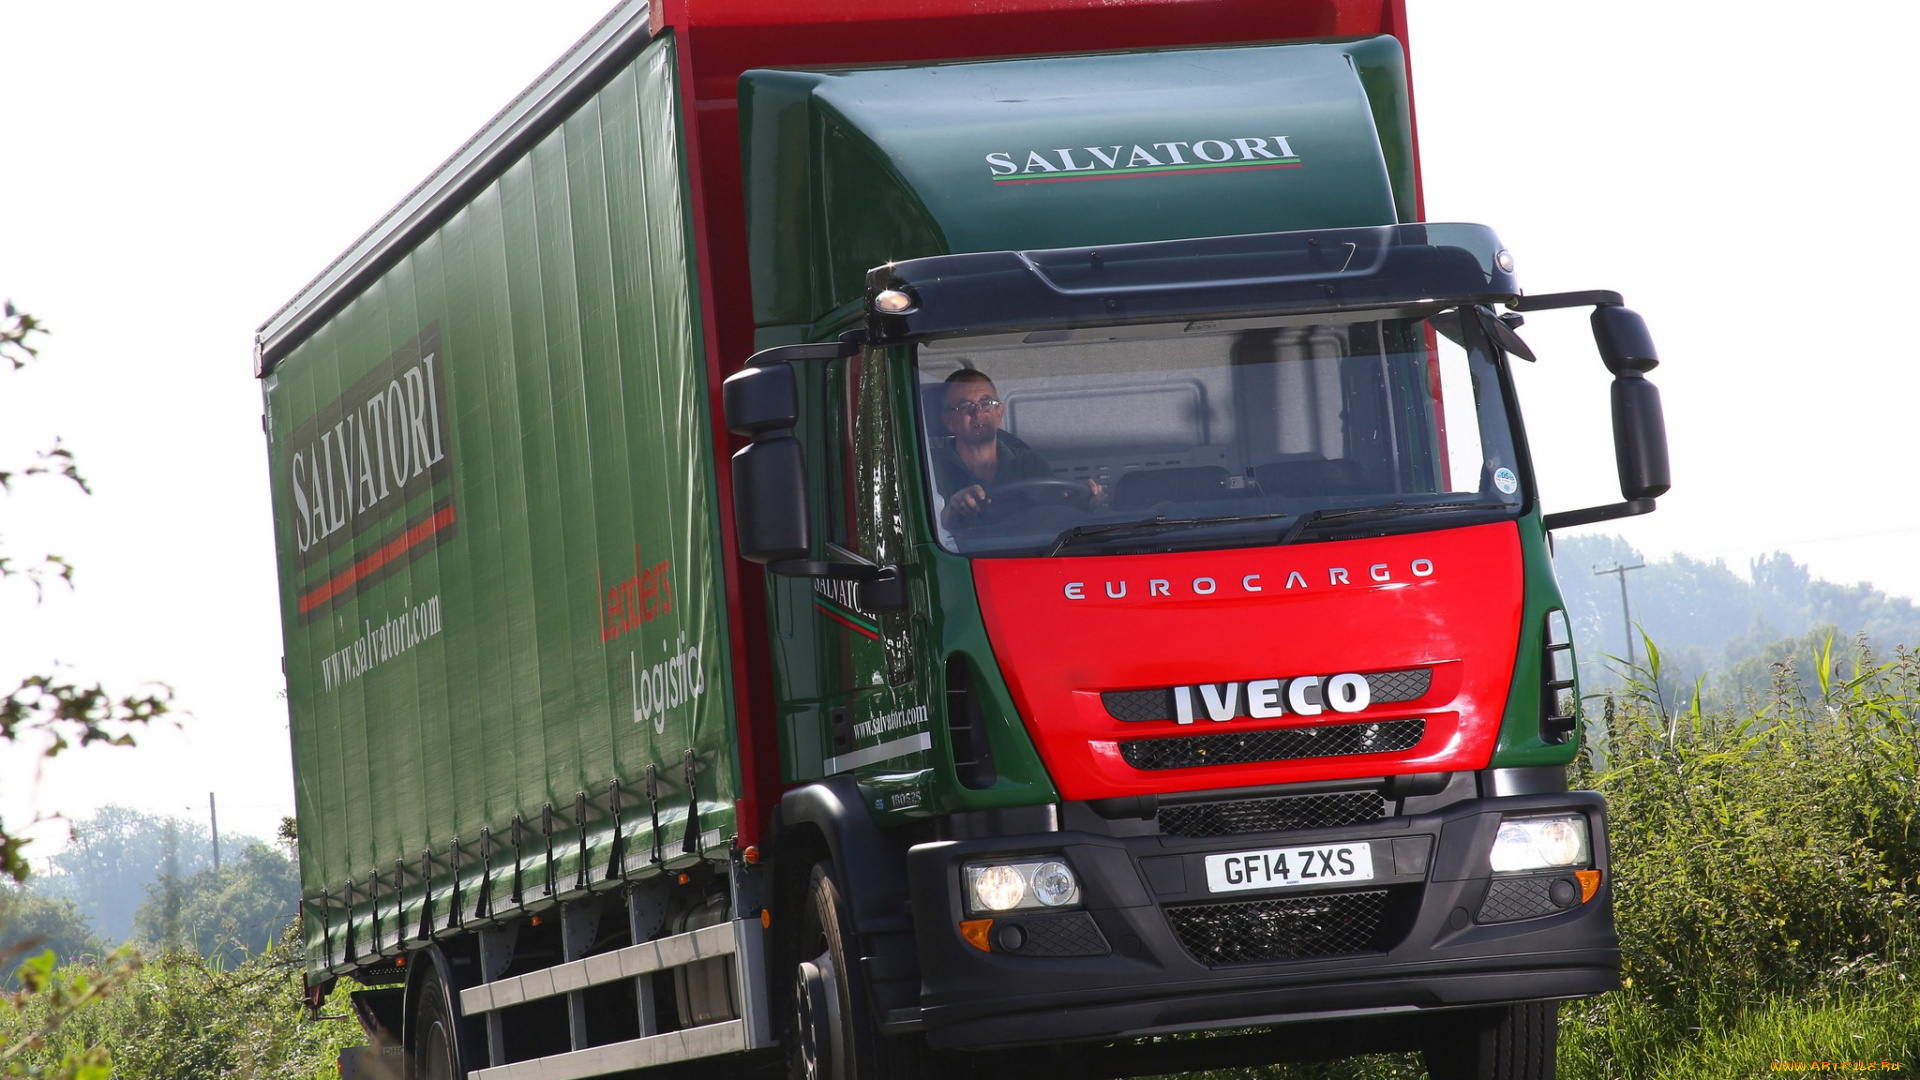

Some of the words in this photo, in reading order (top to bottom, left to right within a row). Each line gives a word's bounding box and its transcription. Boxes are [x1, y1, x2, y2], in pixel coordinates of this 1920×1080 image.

[985, 135, 1299, 176] SALVATORI
[291, 352, 445, 555] SALVATORI
[597, 543, 672, 643] Leaders
[814, 578, 877, 621] SALVATO
[1064, 558, 1434, 600] EUROCARGO
[321, 594, 442, 694] www.salvatori.com
[1173, 672, 1371, 725] IVECO
[853, 705, 928, 740] www.salvatori.com
[1224, 853, 1290, 886] GF14
[1300, 848, 1355, 879] ZXS
